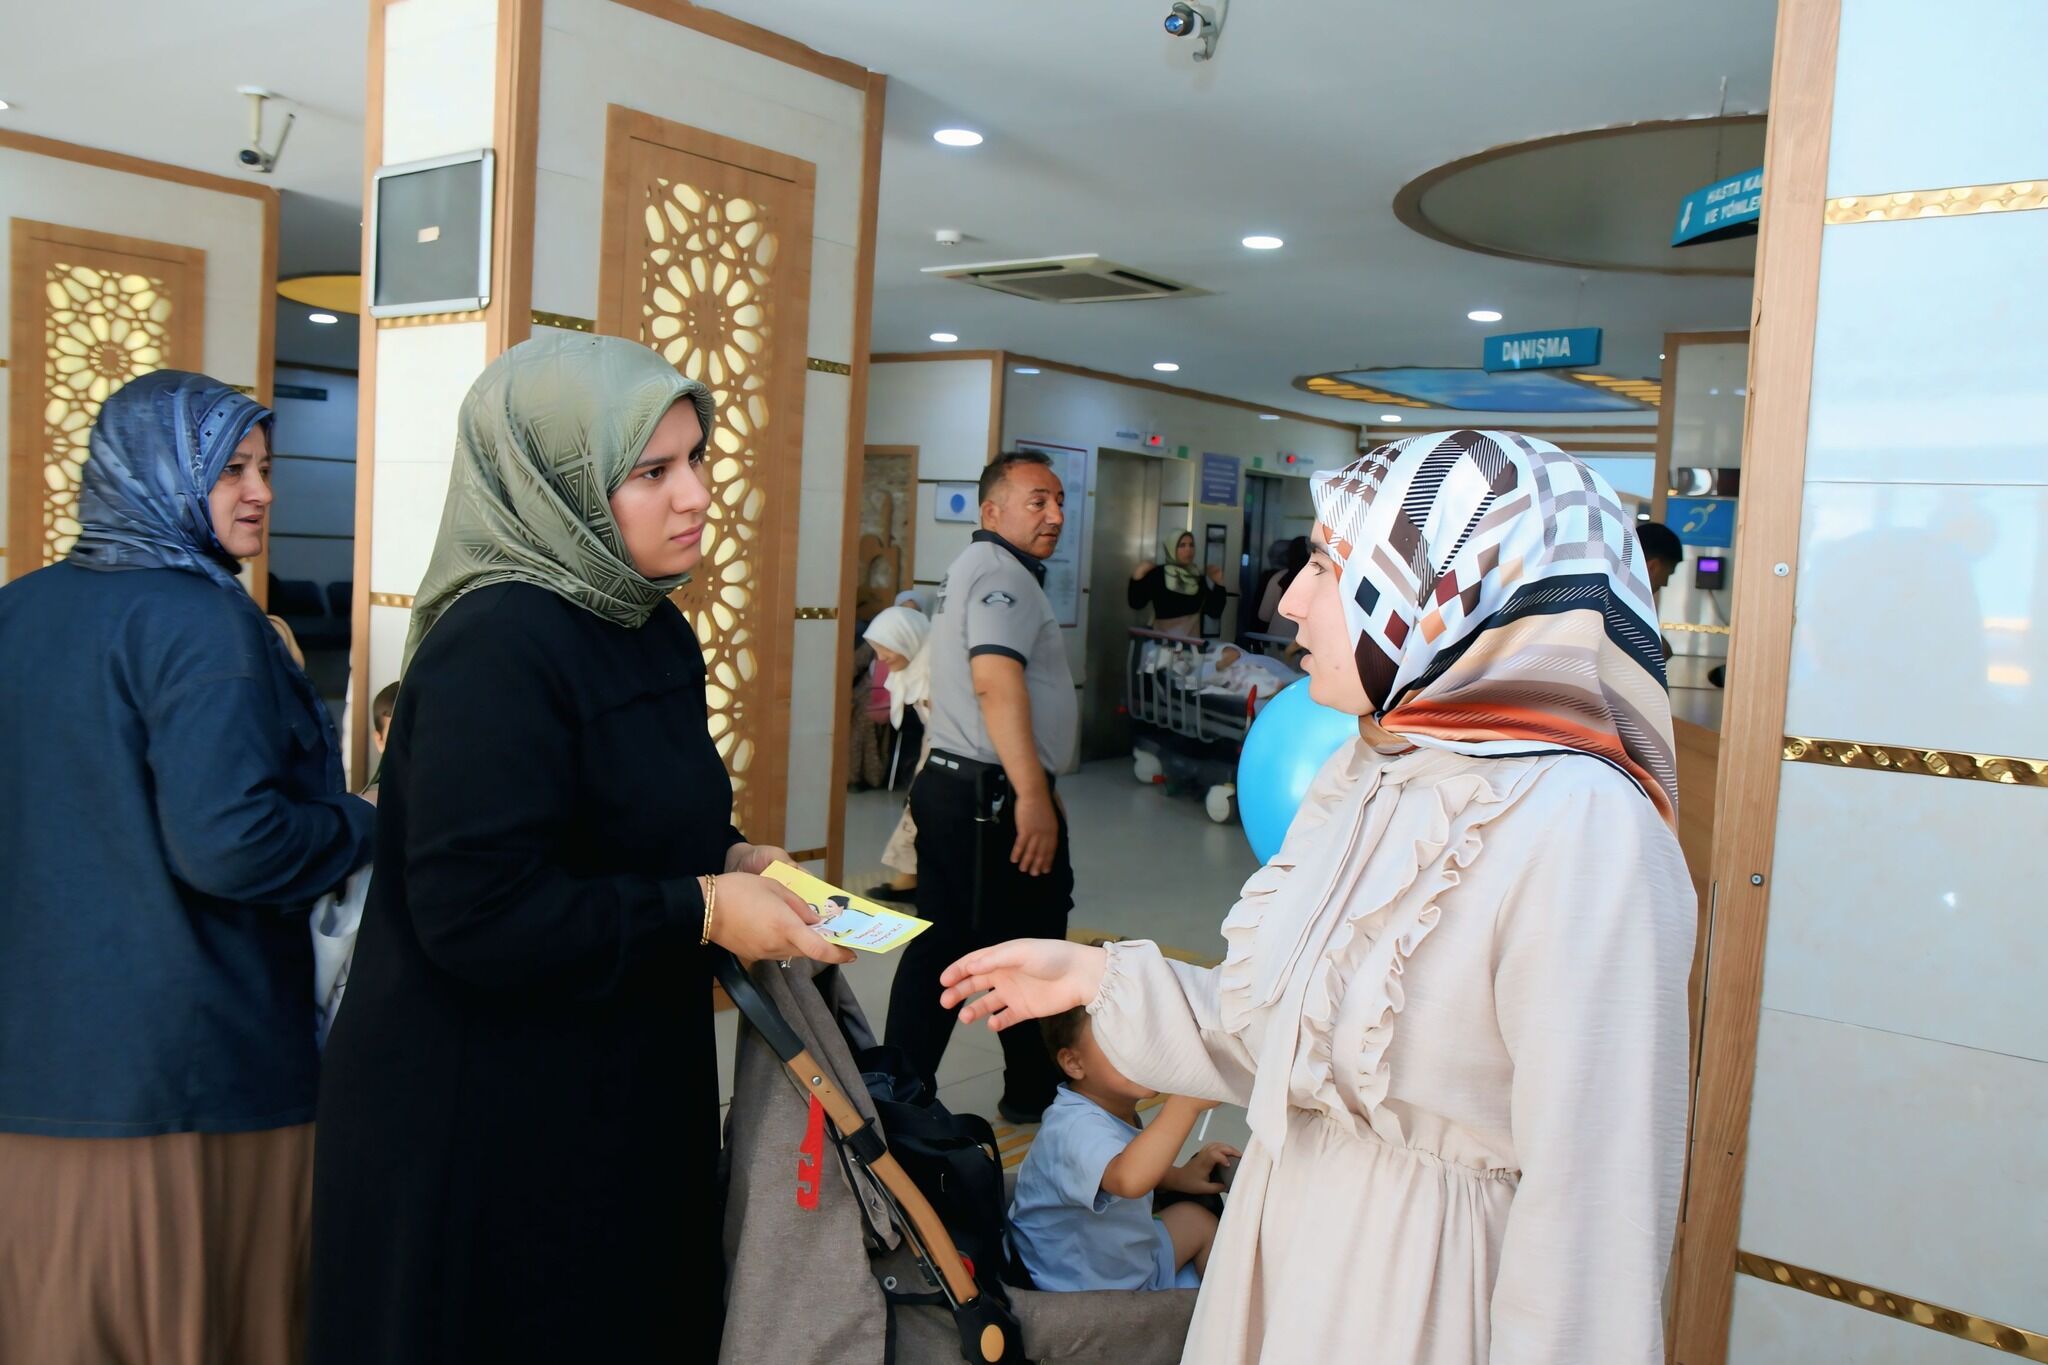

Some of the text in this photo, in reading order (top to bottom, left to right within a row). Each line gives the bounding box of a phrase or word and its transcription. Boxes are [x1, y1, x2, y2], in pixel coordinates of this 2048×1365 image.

[1706, 181, 1741, 204] HASTA
[1704, 208, 1719, 225] VE
[1502, 336, 1571, 365] DANIŞMA
